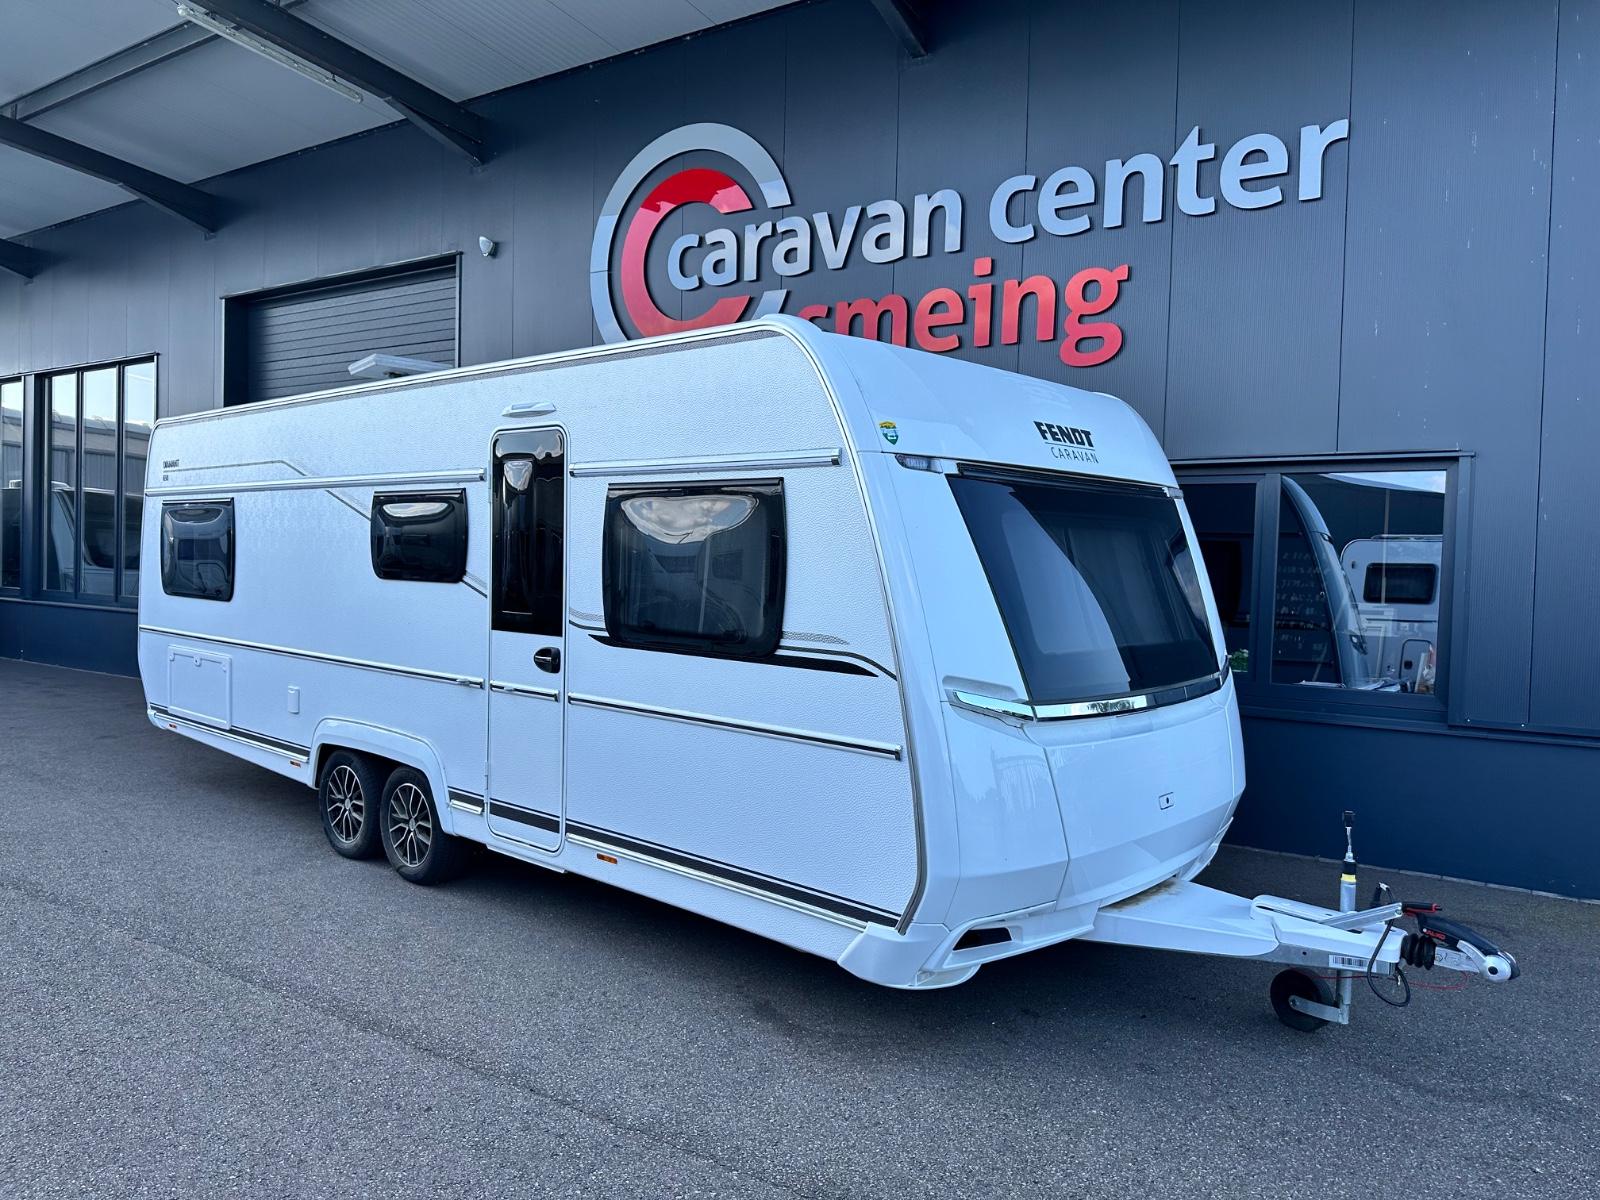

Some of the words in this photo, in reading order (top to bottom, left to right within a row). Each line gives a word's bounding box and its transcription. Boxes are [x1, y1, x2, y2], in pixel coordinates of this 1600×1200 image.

[667, 189, 962, 291] caravan
[989, 118, 1349, 243] center
[1033, 421, 1094, 447] FENDT
[1050, 446, 1099, 463] CARAVAN
